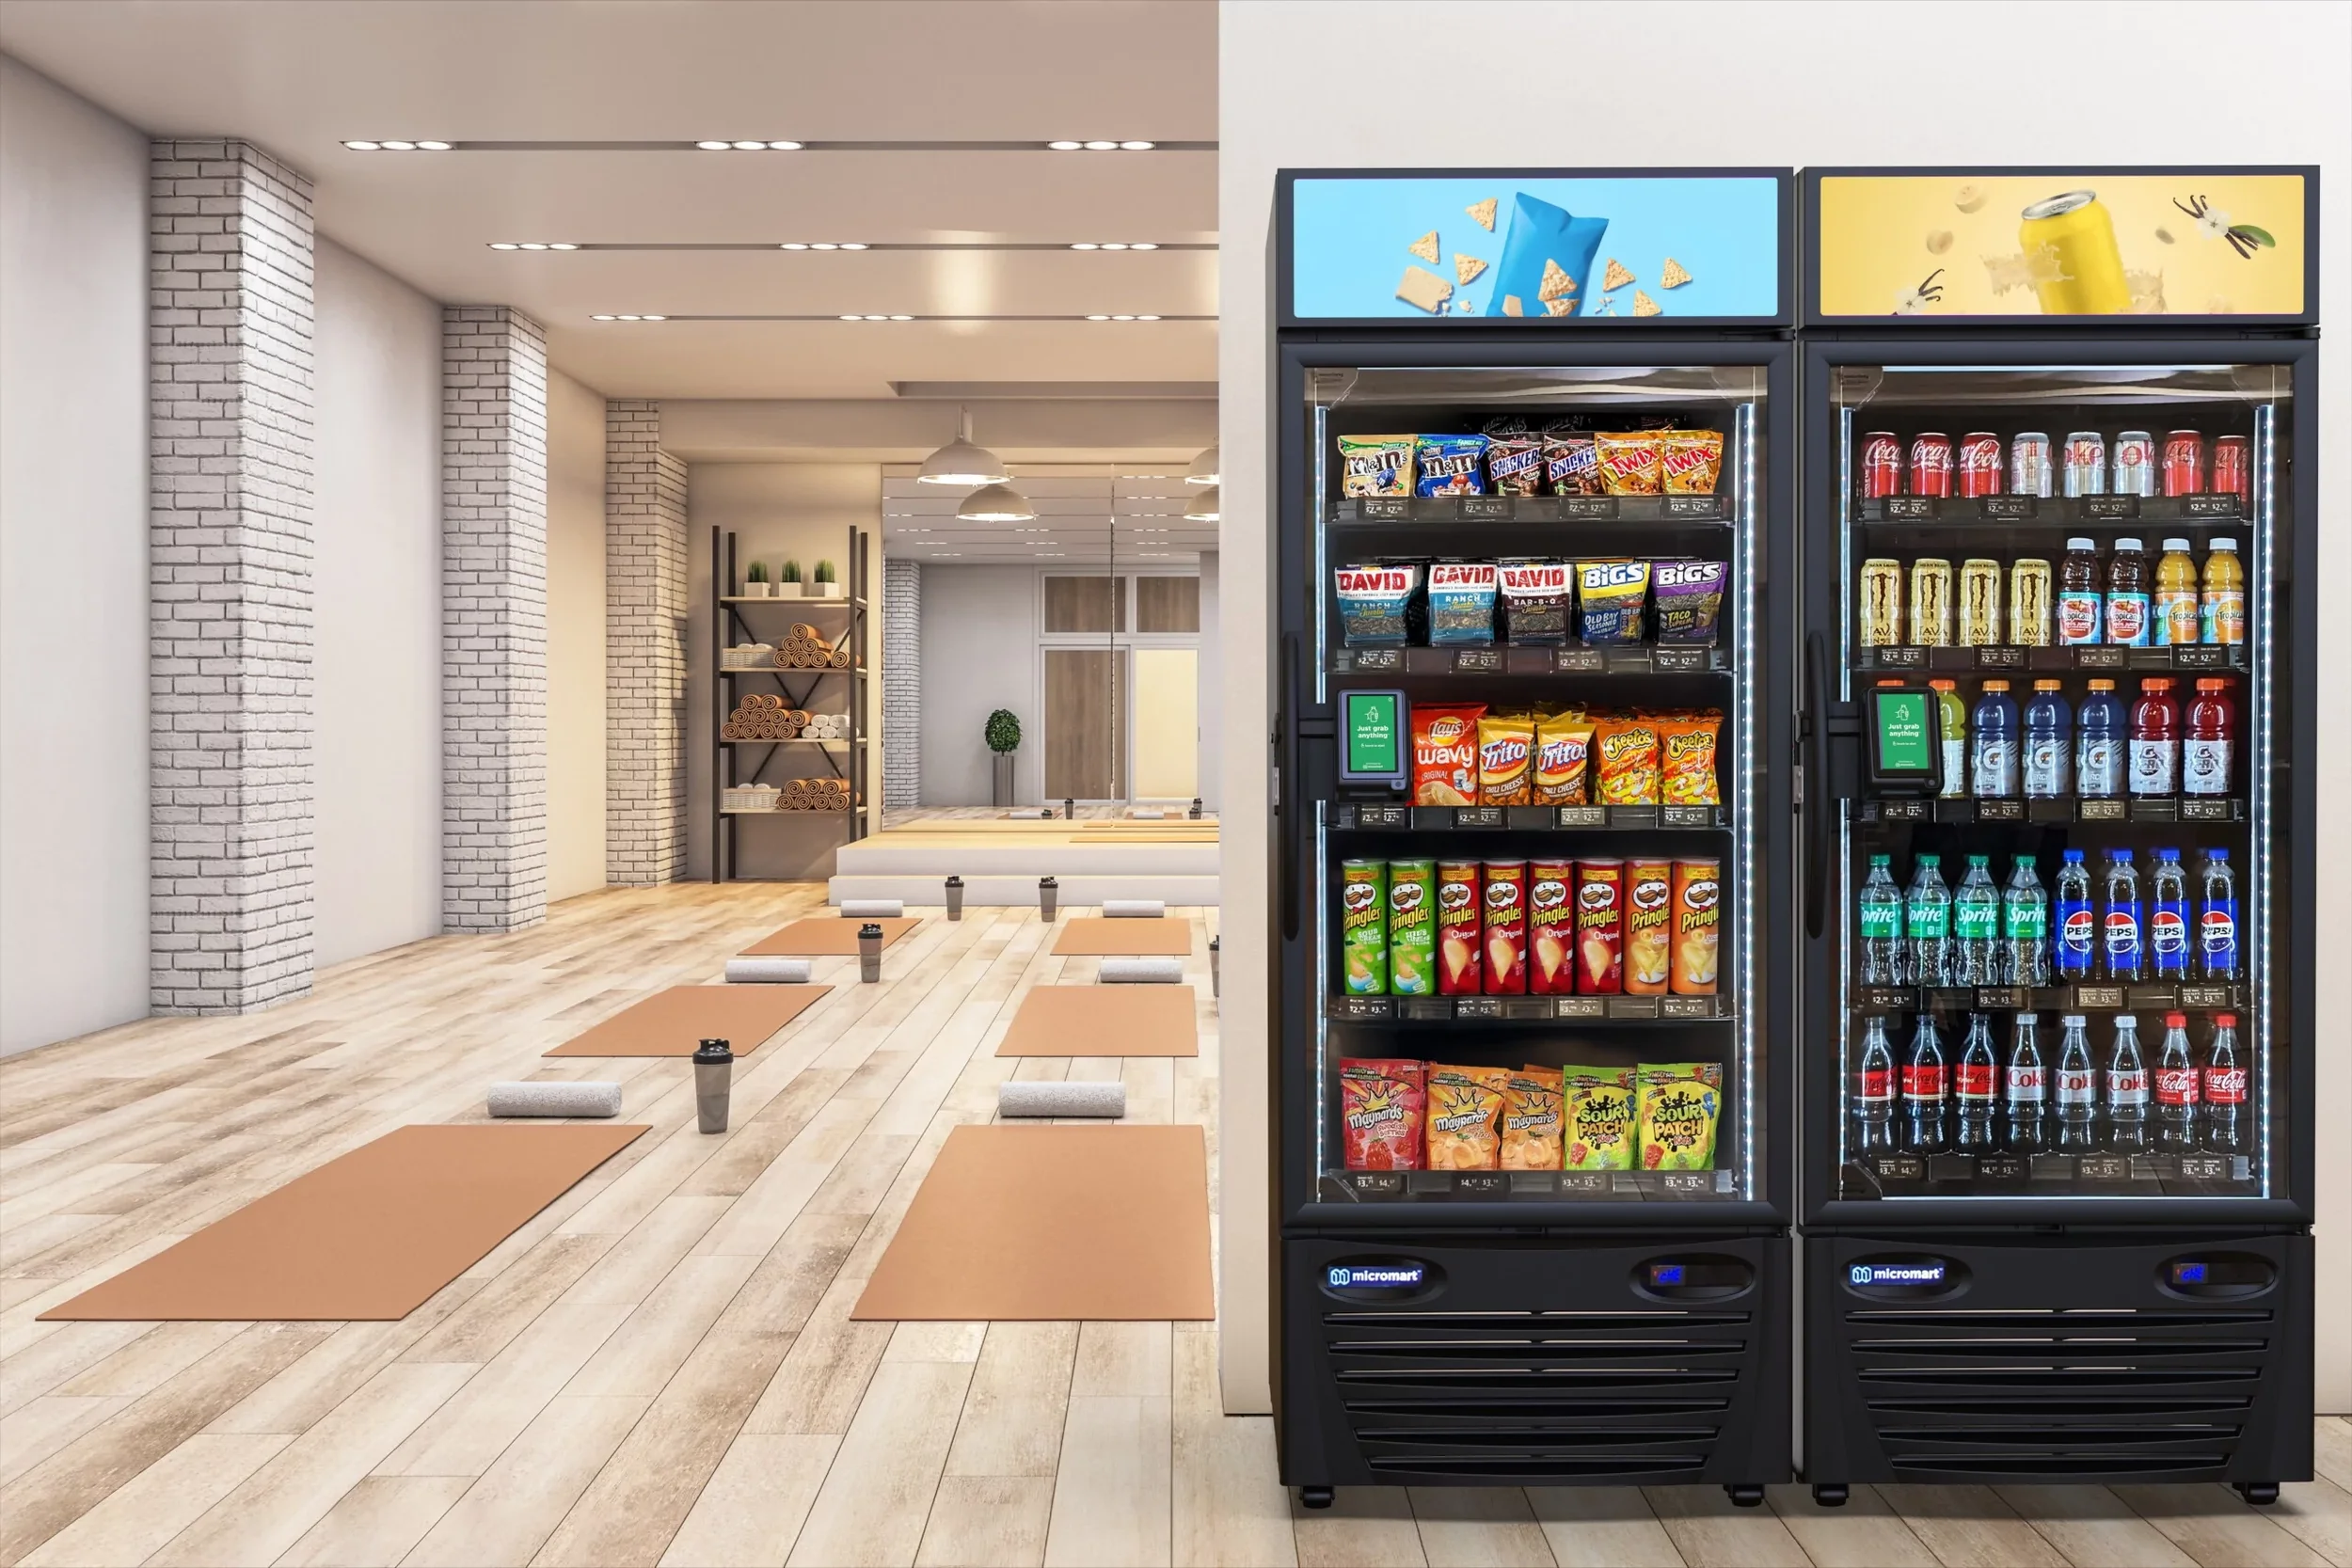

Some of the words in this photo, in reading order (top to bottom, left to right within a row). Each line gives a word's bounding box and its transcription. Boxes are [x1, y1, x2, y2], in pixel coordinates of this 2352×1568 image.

[1337, 573, 1406, 591] DAVID
[1503, 568, 1565, 587] DAVID
[1585, 614, 1602, 626] OLD
[1602, 611, 1619, 625] BAY
[1668, 610, 1691, 622] TACO
[1604, 728, 1654, 758] Cheetos
[1418, 744, 1473, 768] wavy
[1480, 739, 1528, 771] Frito
[1532, 905, 1569, 930] Pringles
[1579, 907, 1618, 932] Pringles
[2008, 1069, 2046, 1088] Coke
[1581, 1104, 1625, 1122] SOUR
[1657, 1103, 1703, 1122] SOUR
[1578, 1119, 1626, 1137] PATCH
[1654, 1118, 1703, 1137] PATCH
